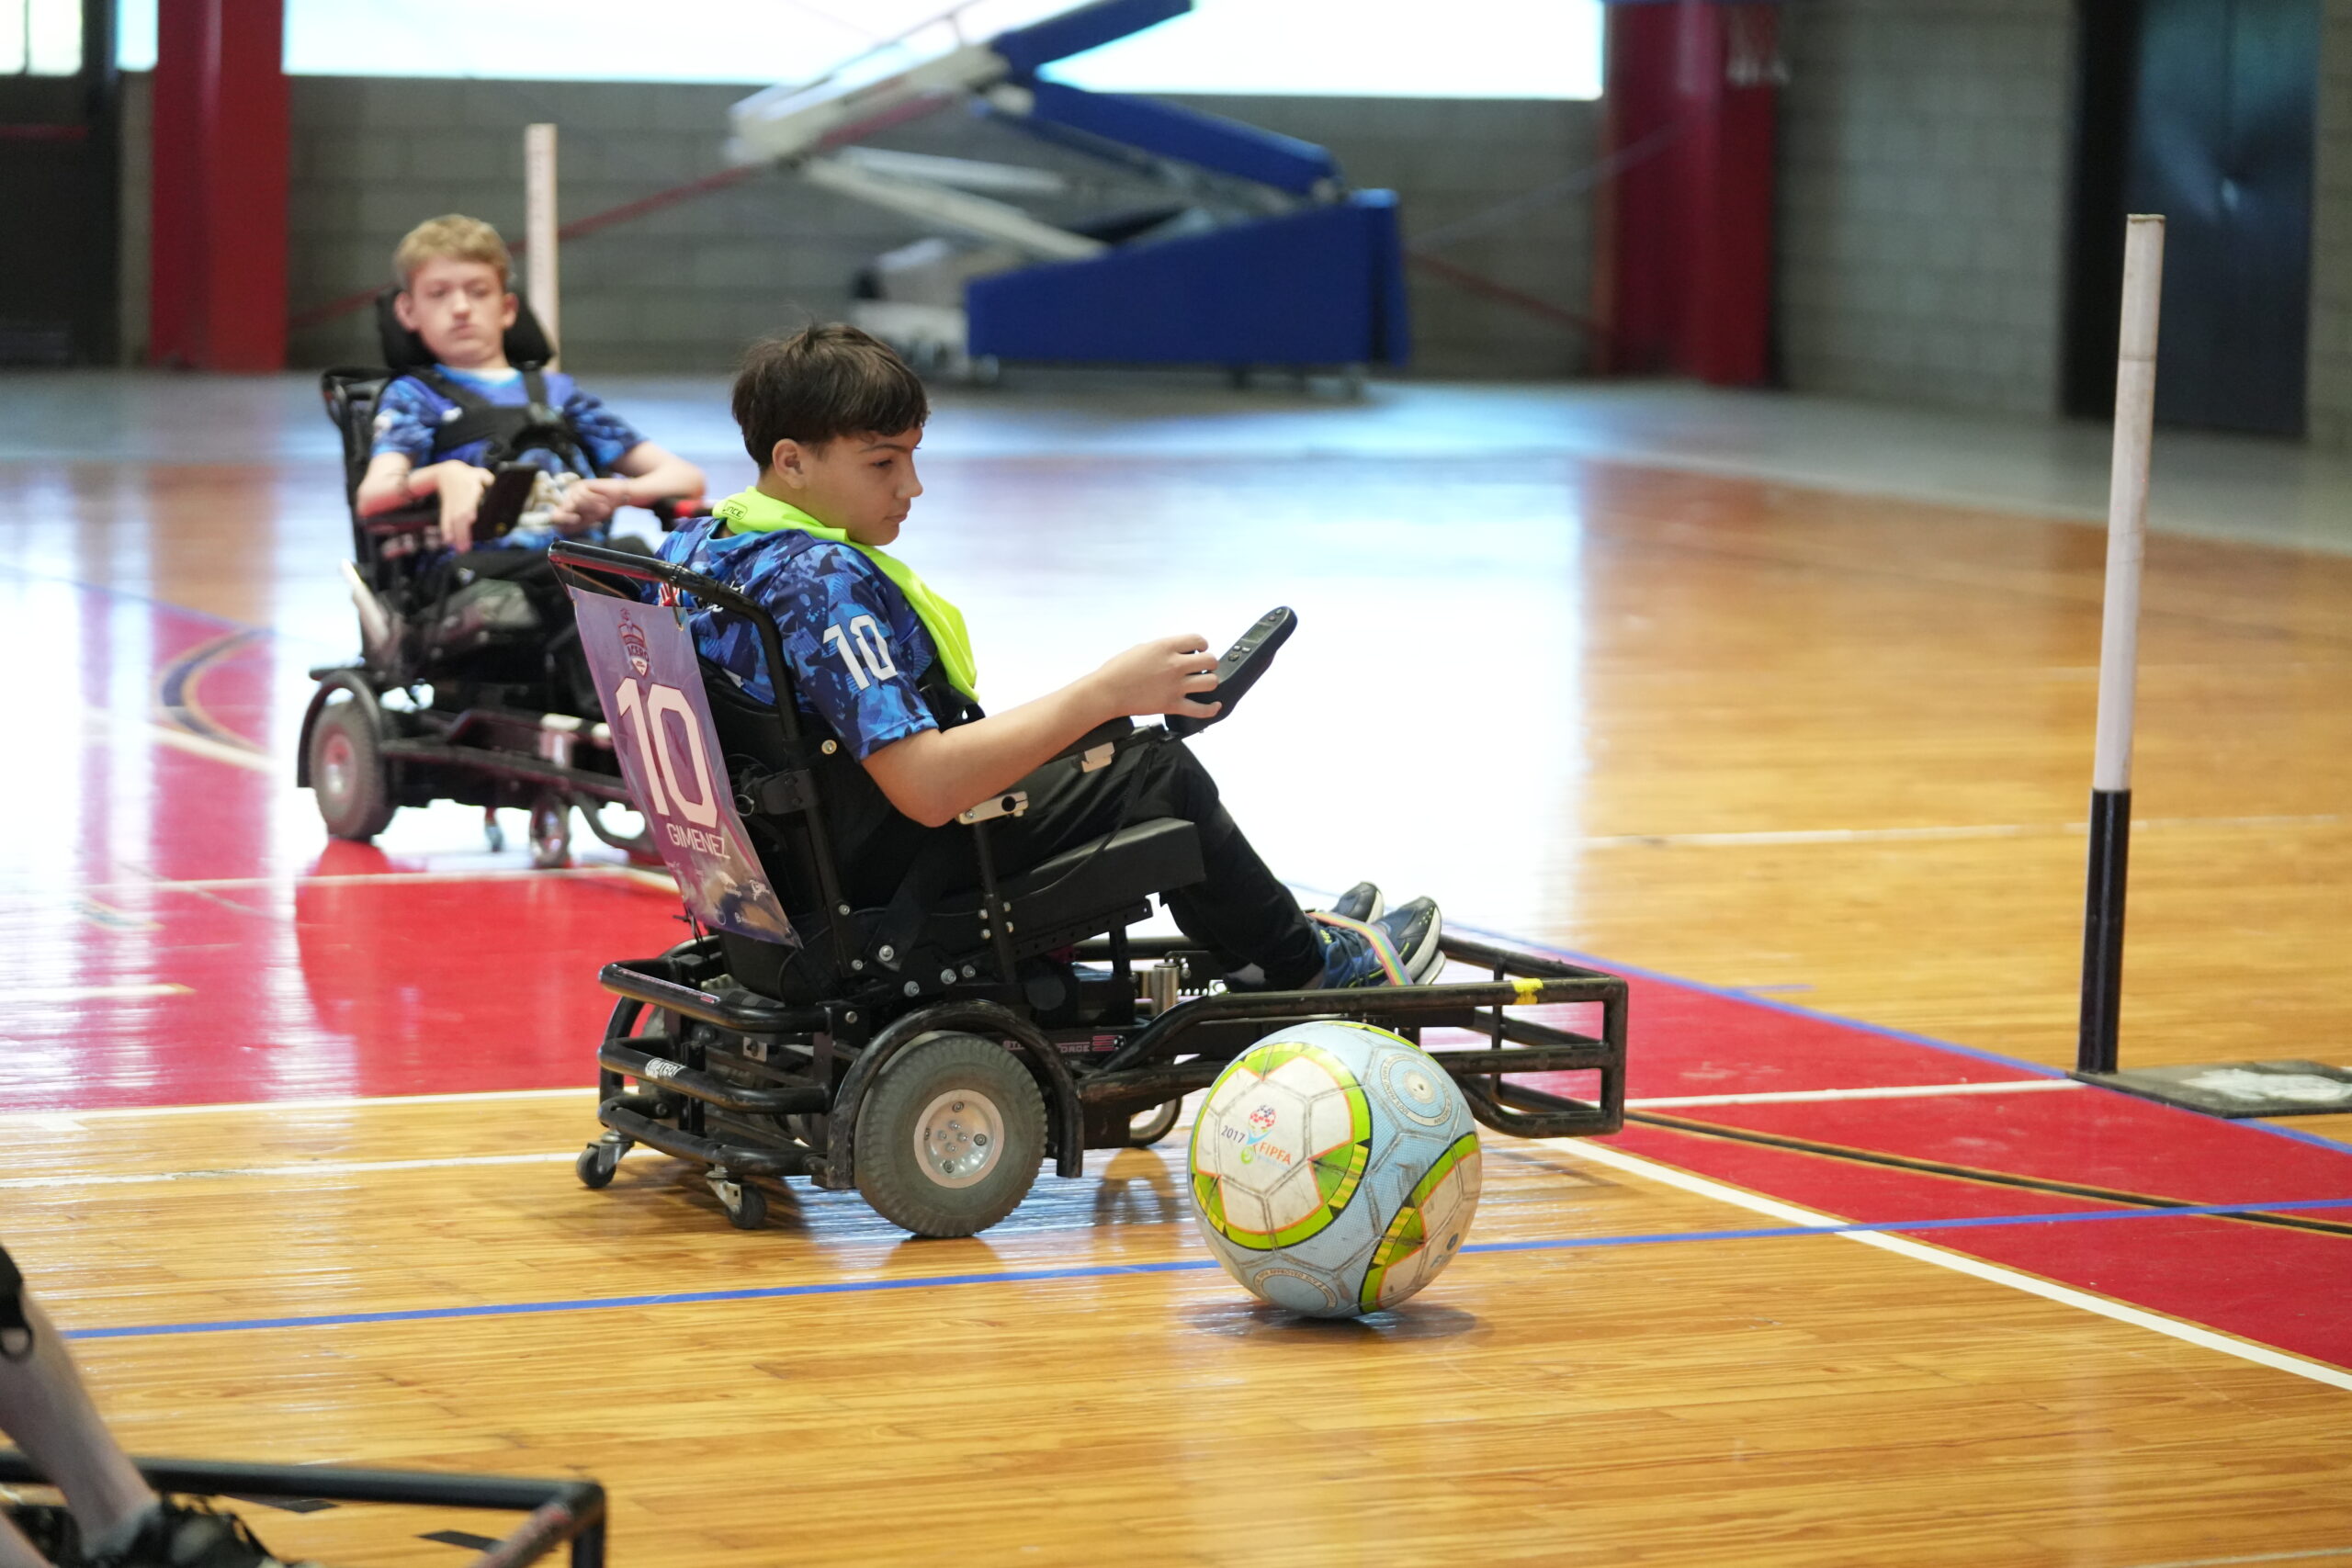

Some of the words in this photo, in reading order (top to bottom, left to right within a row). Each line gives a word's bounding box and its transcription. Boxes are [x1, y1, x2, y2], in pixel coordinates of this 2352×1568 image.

[822, 615, 898, 691] 10
[615, 677, 718, 829] 10
[667, 822, 731, 861] GIMENEZ
[1058, 1044, 1091, 1054] ORCE
[1221, 1125, 1245, 1144] 2017
[1260, 1142, 1291, 1165] FIPFA
